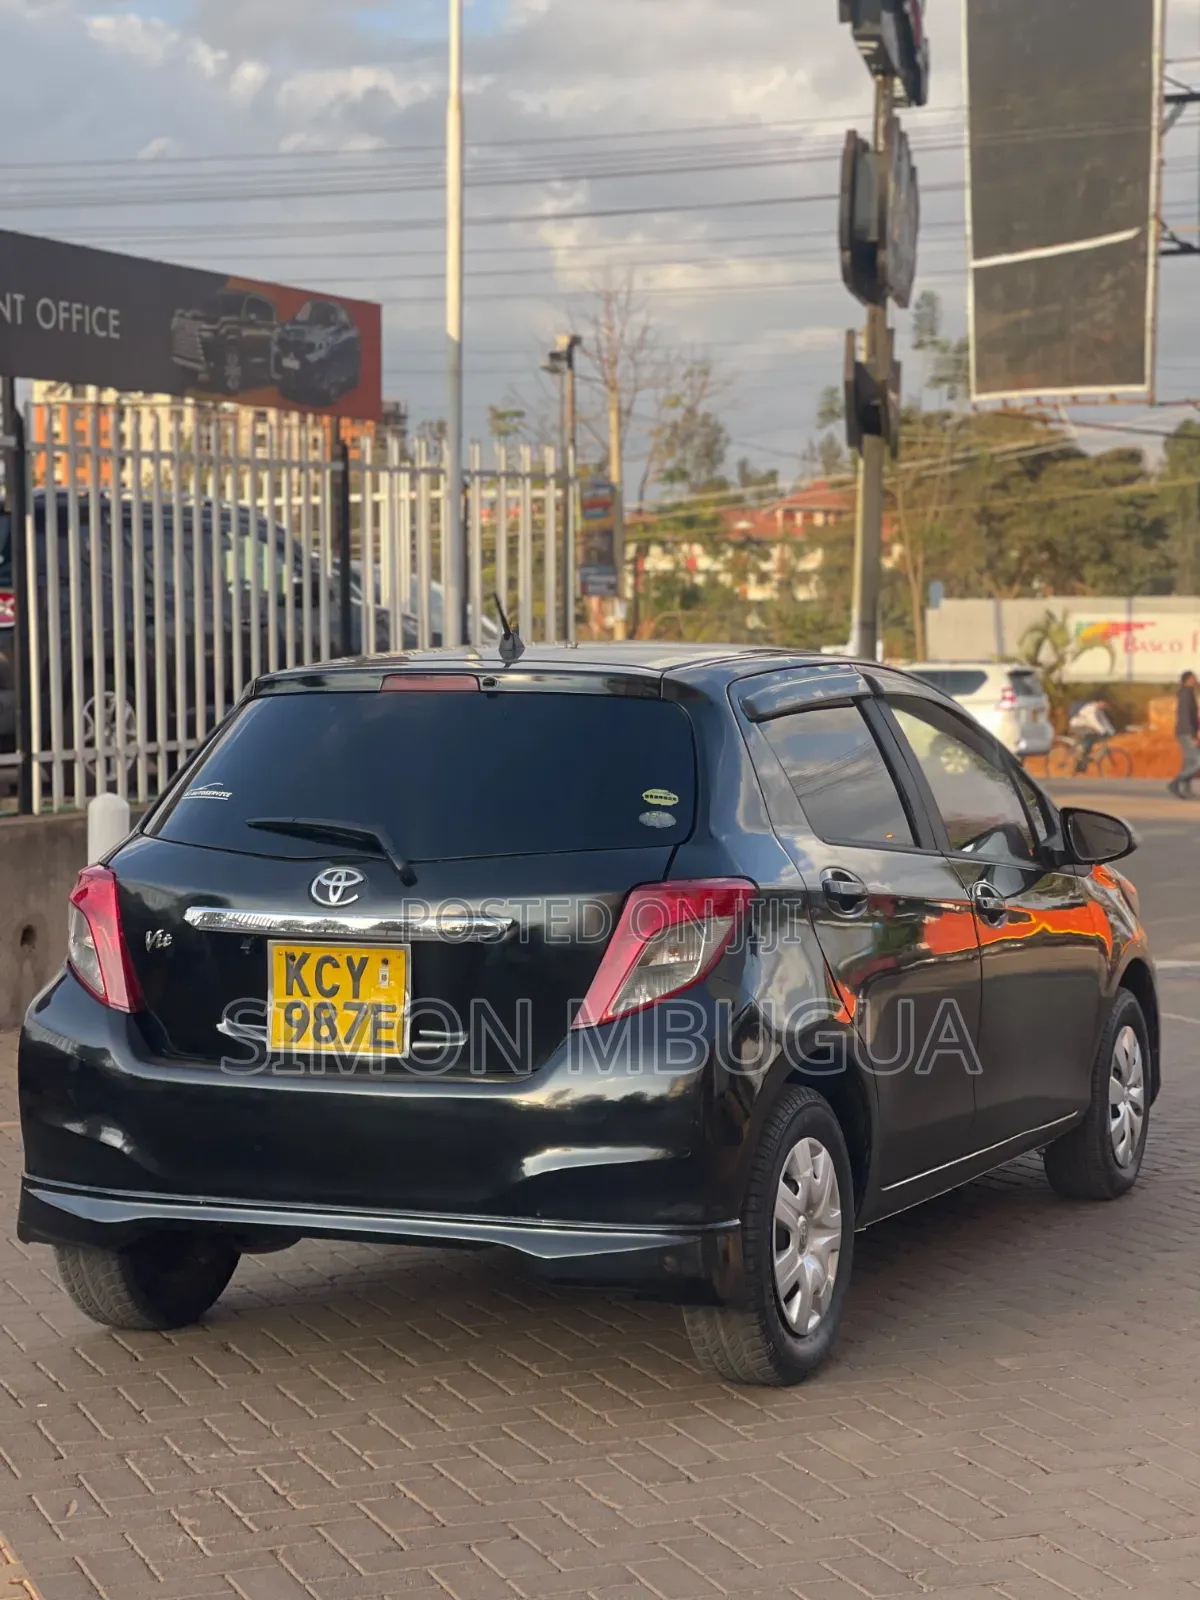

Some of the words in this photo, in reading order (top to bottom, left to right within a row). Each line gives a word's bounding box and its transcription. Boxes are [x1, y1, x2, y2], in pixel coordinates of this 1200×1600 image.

[36, 298, 120, 339] OFFICE
[284, 951, 370, 999] KCY
[284, 1002, 398, 1048] 987E
